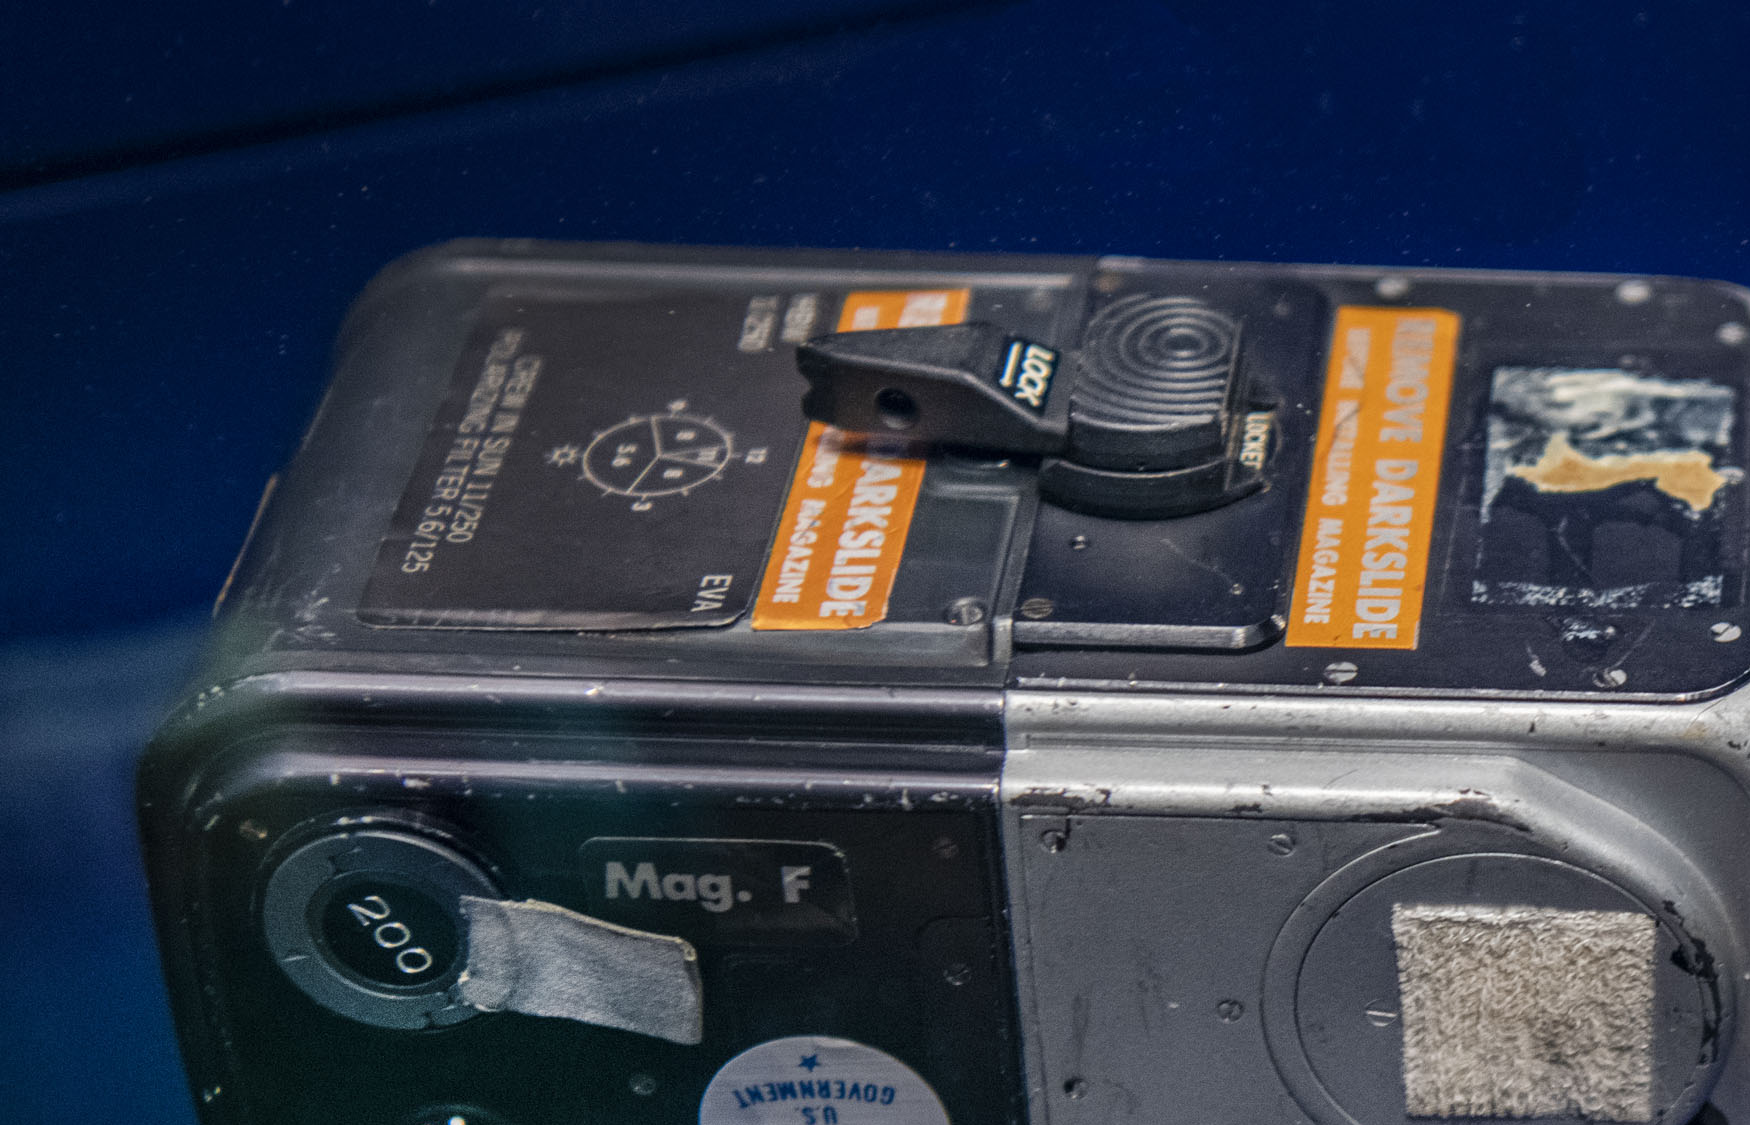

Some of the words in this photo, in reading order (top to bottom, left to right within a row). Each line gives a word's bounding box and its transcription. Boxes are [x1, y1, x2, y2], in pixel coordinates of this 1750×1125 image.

[1013, 343, 1054, 407] LOCK
[1379, 318, 1436, 443] REMOVE
[432, 437, 480, 501] FILTER
[473, 435, 512, 477] SUN
[401, 504, 453, 574] 5.6/125
[446, 481, 494, 543] 11/250
[819, 458, 903, 618] ARKSLIDE
[772, 498, 827, 604] MAGAZINE
[1303, 517, 1344, 624] MAGAZINE
[1352, 458, 1419, 639] DARKSLIDE
[690, 574, 733, 613] EVA
[605, 861, 752, 913] Mag.
[781, 866, 811, 903] F
[347, 895, 432, 974] 200
[732, 1079, 896, 1109] GOVERNMENT
[795, 1105, 838, 1125] U.S.
